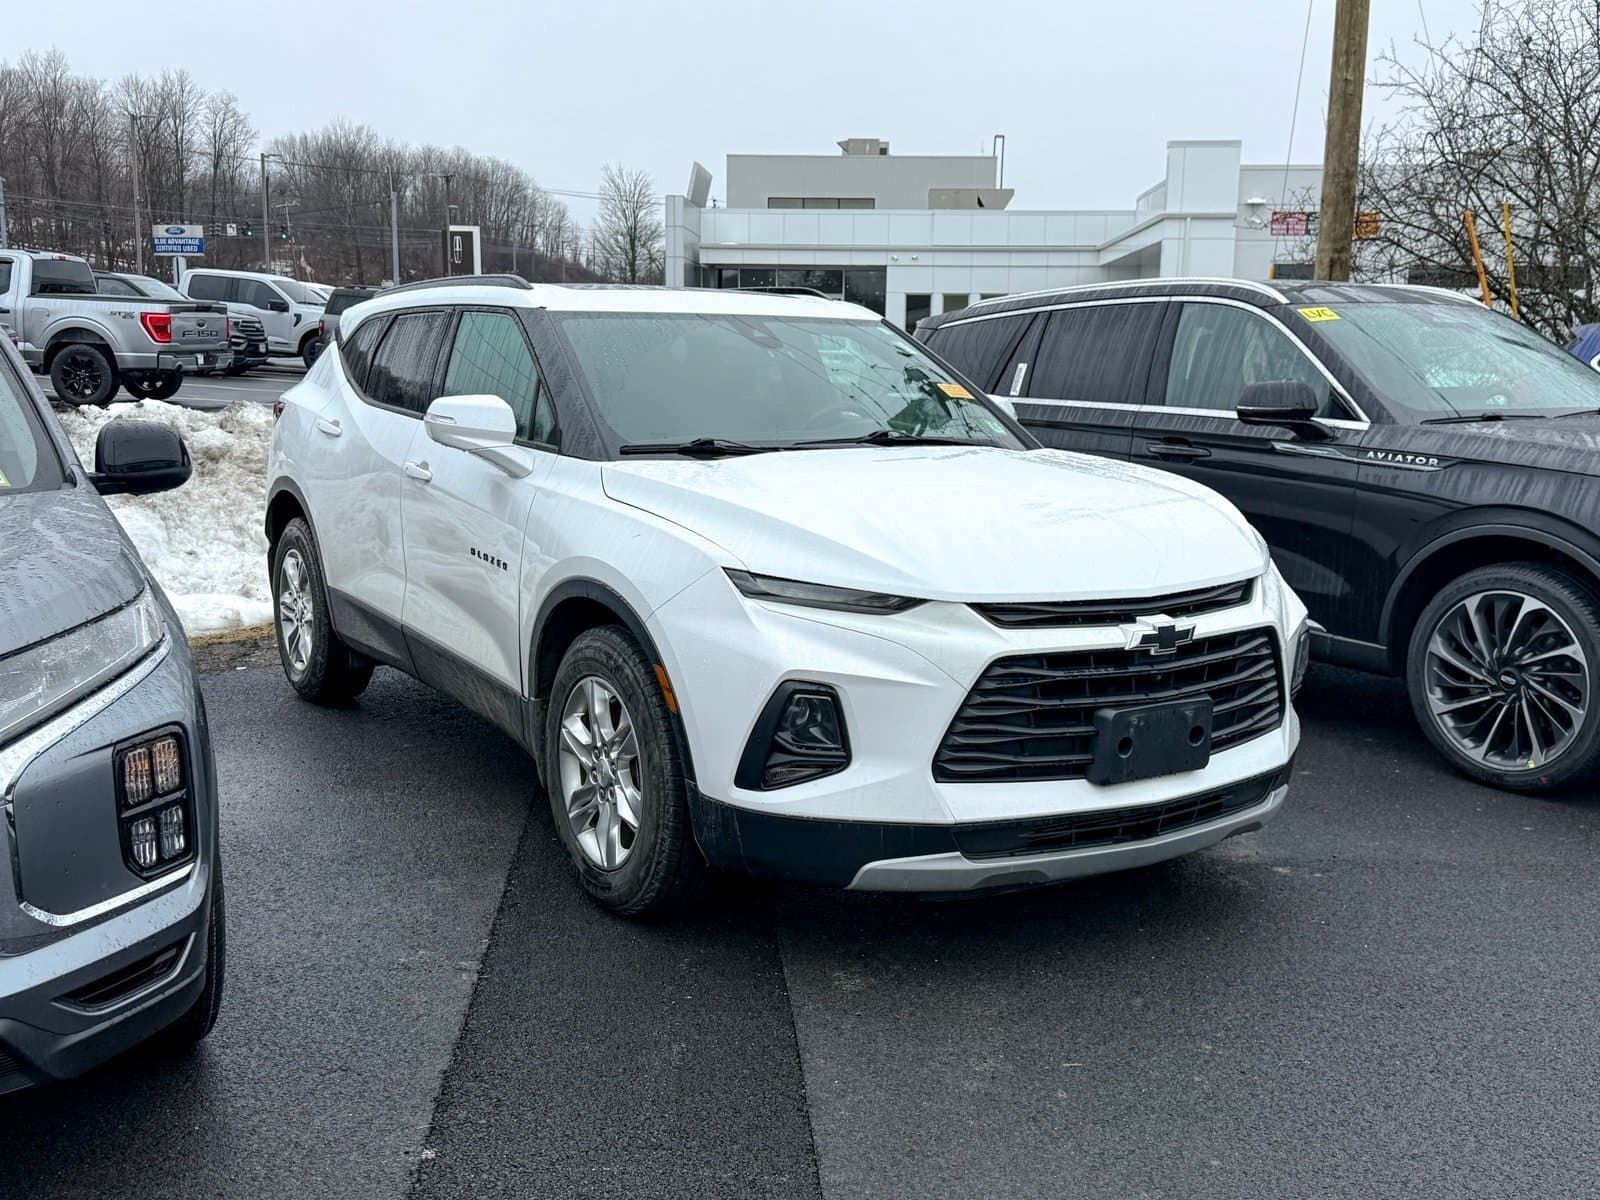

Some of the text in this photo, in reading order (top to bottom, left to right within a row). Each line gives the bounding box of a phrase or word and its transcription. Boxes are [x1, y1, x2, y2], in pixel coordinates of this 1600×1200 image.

[167, 238, 200, 246] ADVANTAGE
[182, 330, 219, 338] F-150
[1367, 450, 1439, 467] AVIATOR
[470, 546, 508, 571] BLAZER
